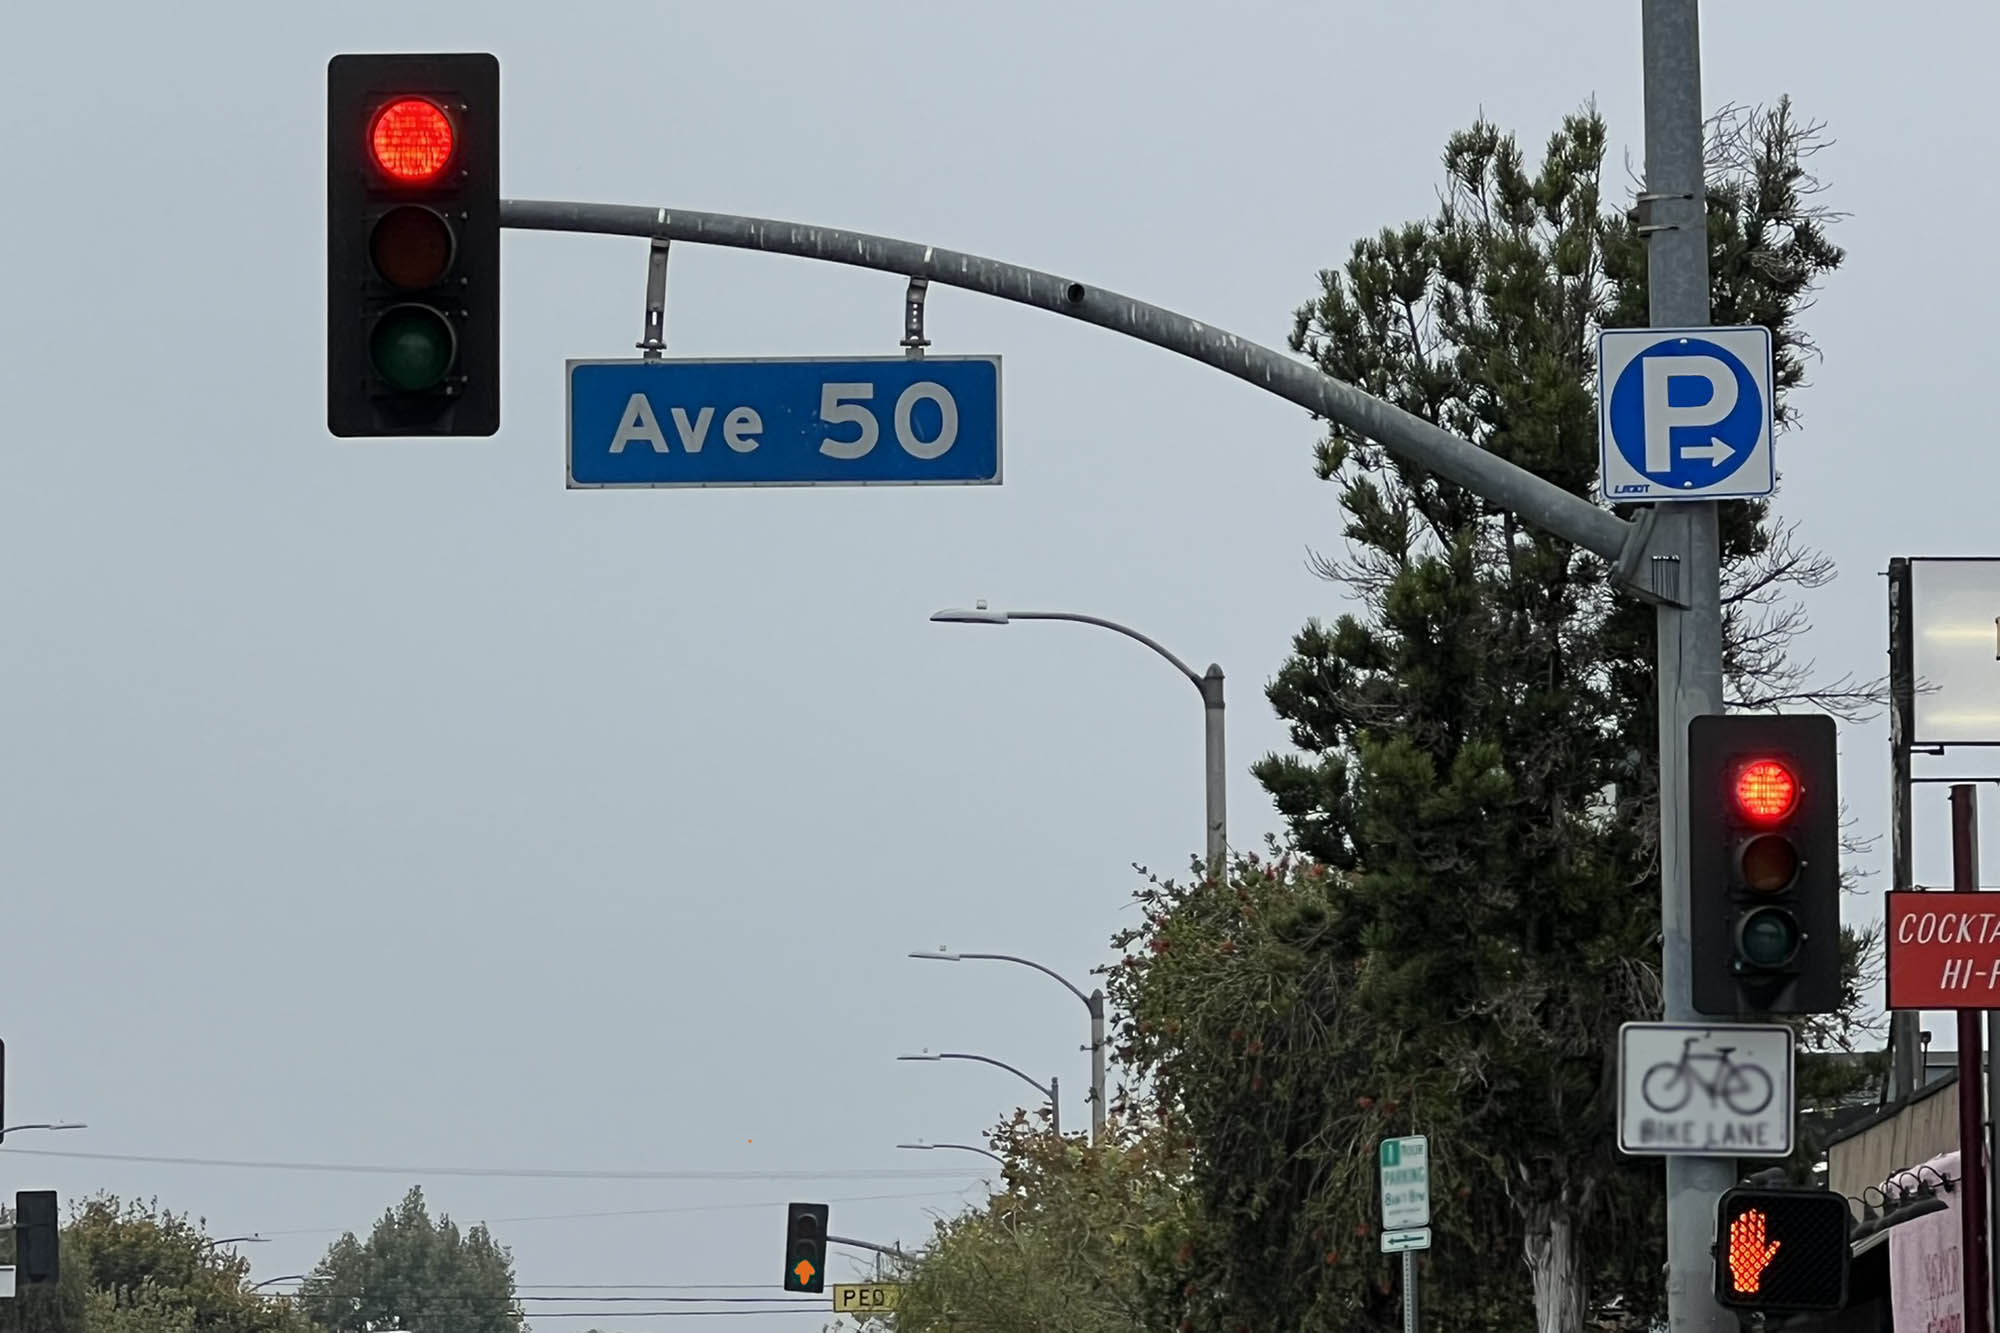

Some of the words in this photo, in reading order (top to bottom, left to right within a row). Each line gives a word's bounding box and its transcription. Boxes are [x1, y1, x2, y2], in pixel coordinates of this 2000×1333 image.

[609, 393, 764, 453] Ave
[819, 381, 959, 459] 50
[1642, 355, 1739, 473] P
[1640, 1117, 1695, 1146] BIKE
[1703, 1121, 1769, 1147] LANE
[843, 1289, 885, 1307] PED
